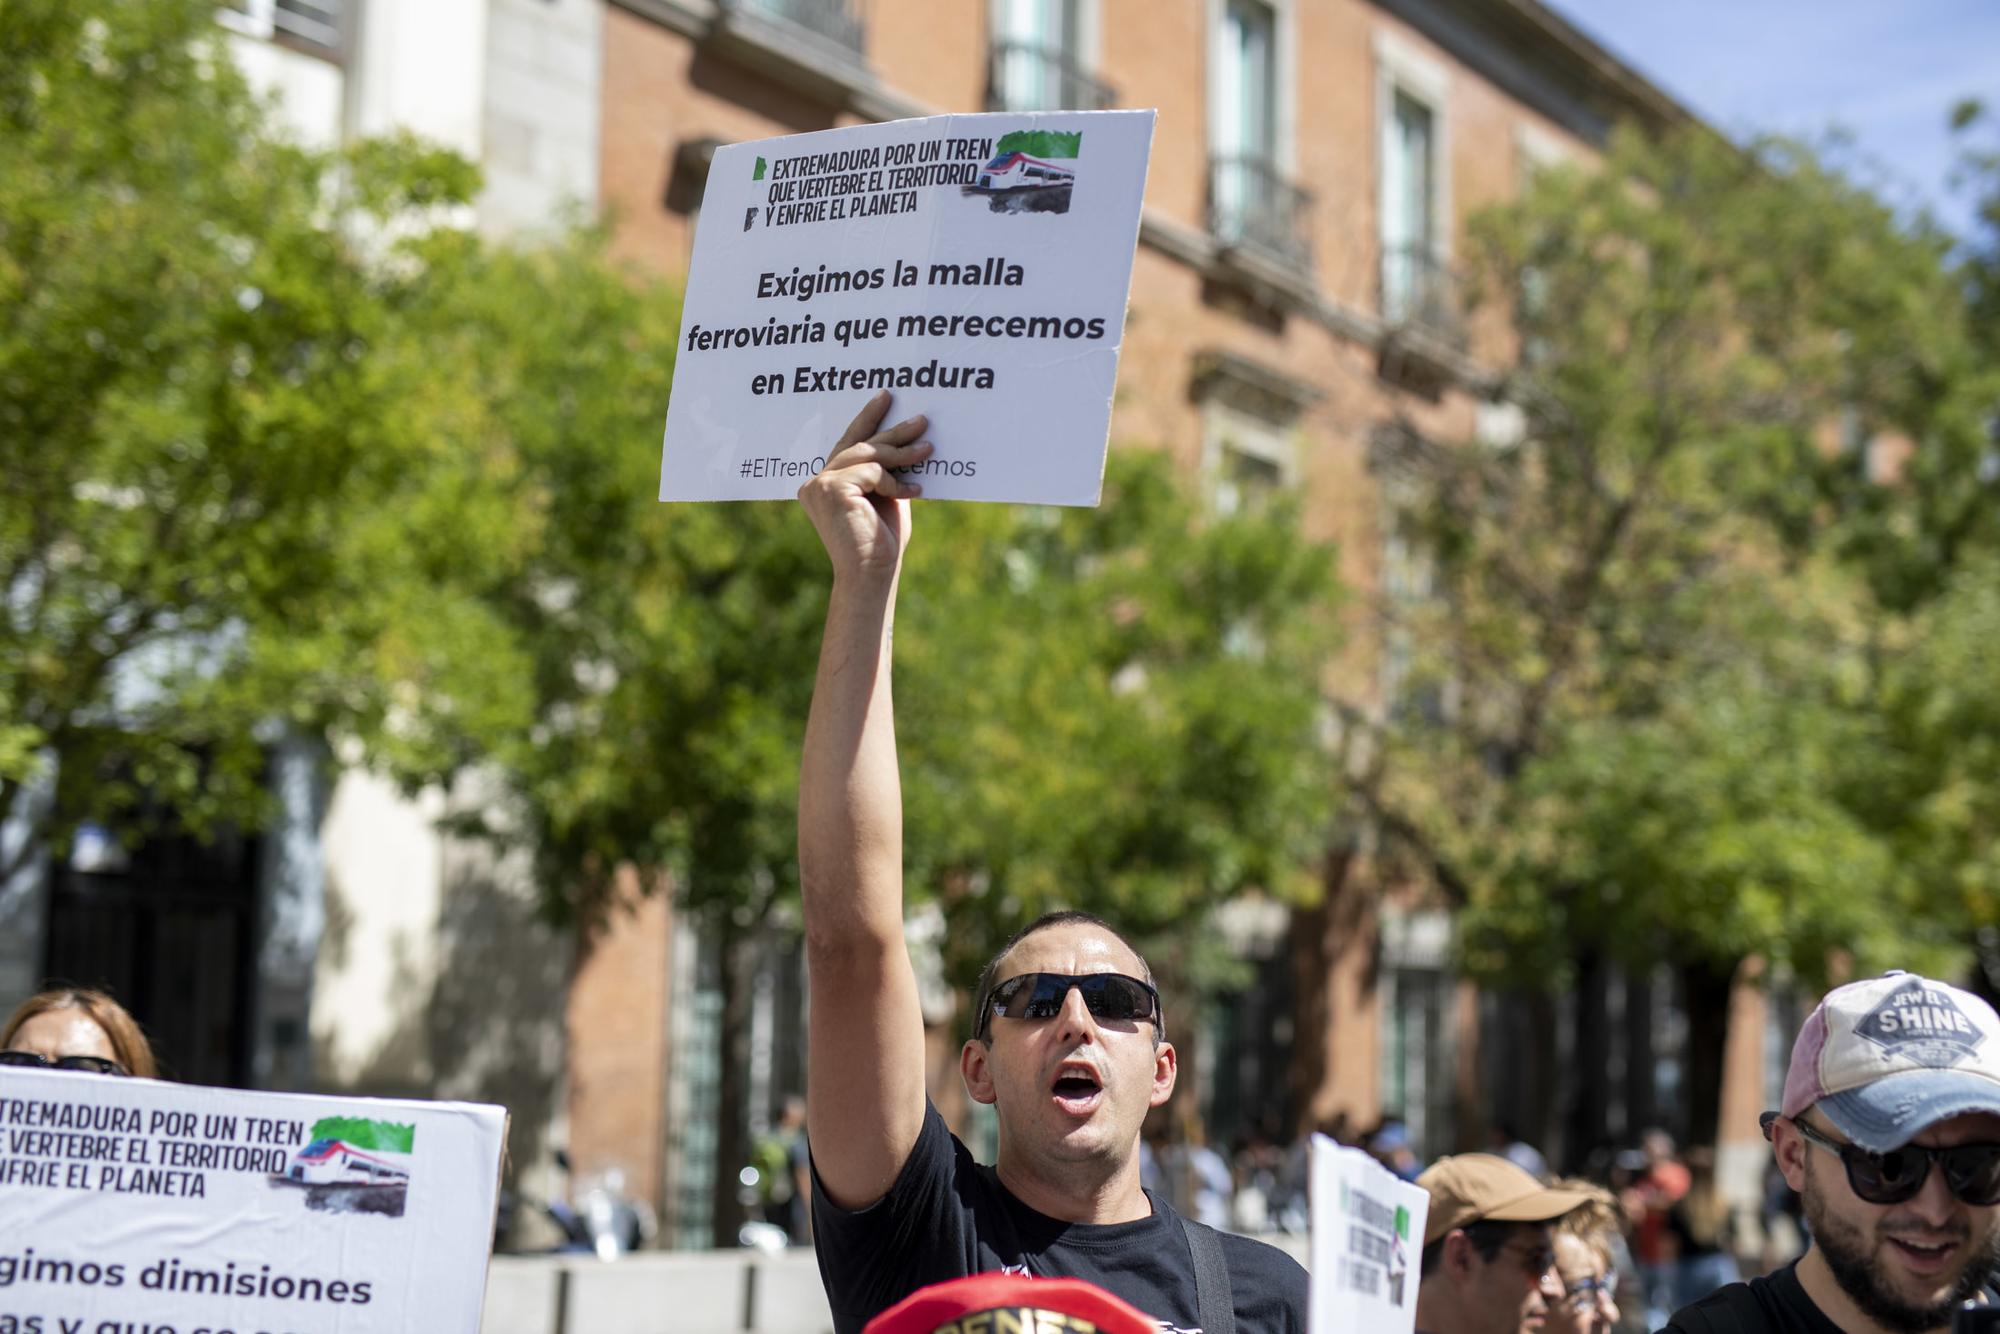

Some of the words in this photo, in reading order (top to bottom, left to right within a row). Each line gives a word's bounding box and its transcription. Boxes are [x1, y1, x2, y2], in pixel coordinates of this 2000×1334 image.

[772, 147, 879, 181] EXTREMADURA
[883, 143, 916, 168] POR
[918, 140, 942, 164] UN
[945, 138, 992, 160] TREN
[768, 180, 797, 204] QUE
[798, 172, 867, 200] VERTEBRE
[868, 170, 885, 192] EL
[888, 163, 979, 190] TERRITORIO
[765, 202, 775, 227] Y
[829, 198, 846, 220] EL
[849, 191, 917, 218] PLANETA
[757, 265, 884, 302] Exigimos
[893, 260, 917, 287] la
[928, 258, 1024, 286] malla
[687, 314, 825, 351] ferroviaria
[834, 318, 888, 347] que
[896, 314, 1106, 340] merecemos
[751, 374, 784, 395] en
[793, 360, 995, 393] Extremadura
[1879, 1006, 1972, 1035] SHINE
[150, 1110, 198, 1138] POR
[203, 1114, 238, 1141] UN
[244, 1117, 304, 1146] TREN
[10, 1129, 124, 1162] VERTEBRE
[126, 1138, 152, 1165] EL
[158, 1140, 287, 1174] TERRITORIO
[66, 1164, 91, 1189] EL
[100, 1165, 206, 1198] PLANETA
[139, 1258, 372, 1304] dimisiones
